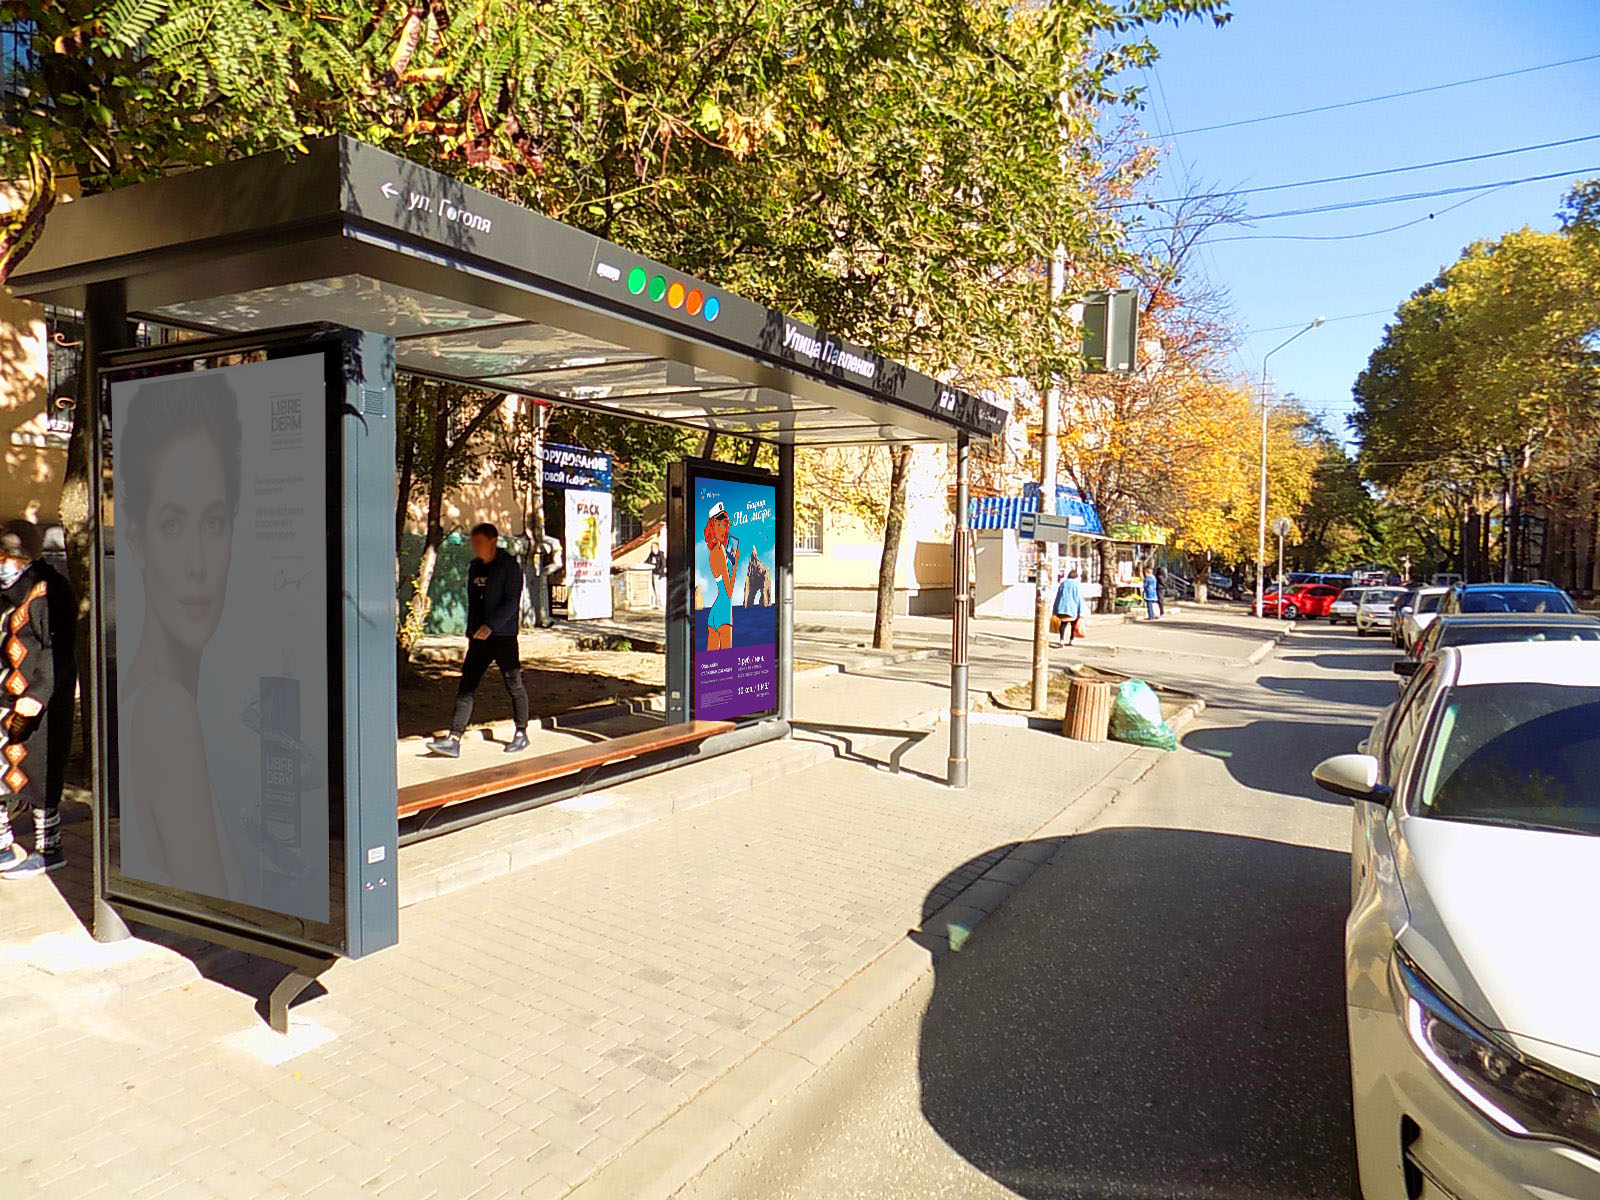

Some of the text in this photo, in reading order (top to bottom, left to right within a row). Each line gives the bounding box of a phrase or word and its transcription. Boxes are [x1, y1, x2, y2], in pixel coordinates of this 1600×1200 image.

[408, 190, 492, 233] ул. Гоголя
[782, 322, 876, 378] Улица Павленко
[271, 398, 302, 416] LIBRE
[271, 414, 302, 432] DERM
[542, 448, 608, 471] ОРУДОВАНИЕ
